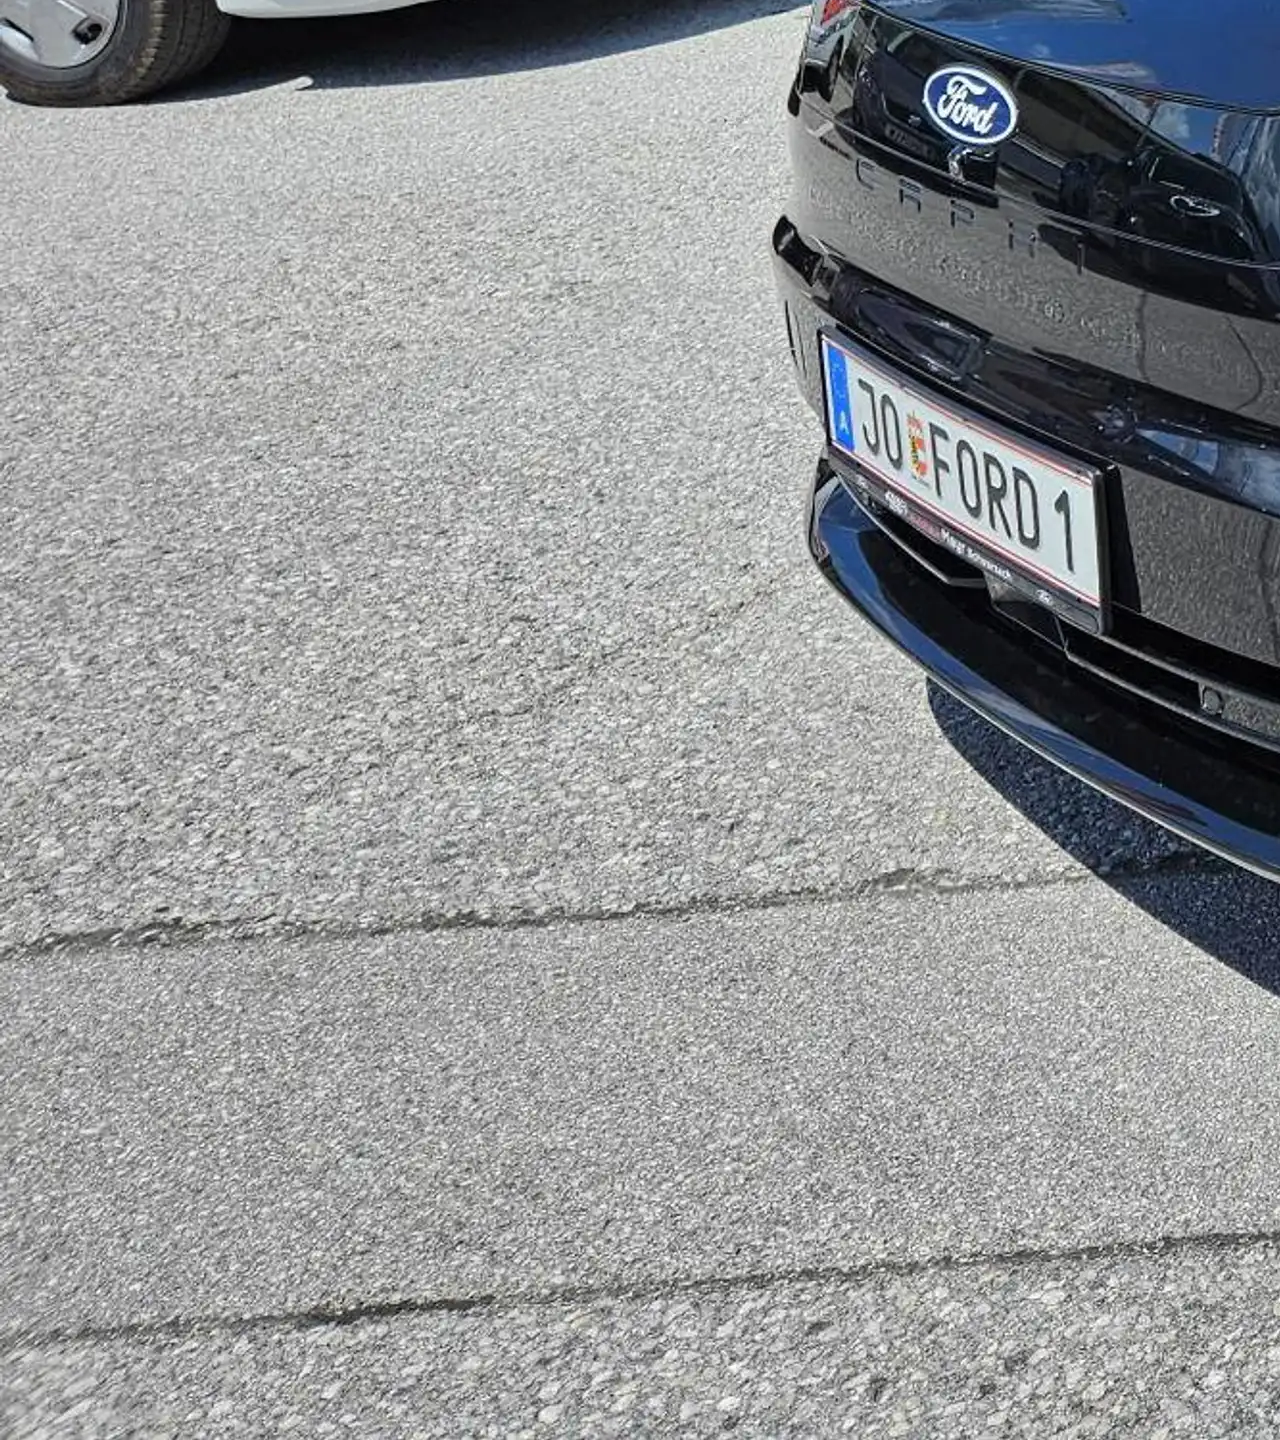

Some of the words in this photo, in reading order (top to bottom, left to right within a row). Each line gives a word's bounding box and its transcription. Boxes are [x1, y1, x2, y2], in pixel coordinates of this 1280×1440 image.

[937, 74, 999, 135] Ford
[839, 411, 850, 434] A
[858, 377, 904, 471] JO
[928, 421, 1041, 551] FORD
[1054, 489, 1075, 575] 1
